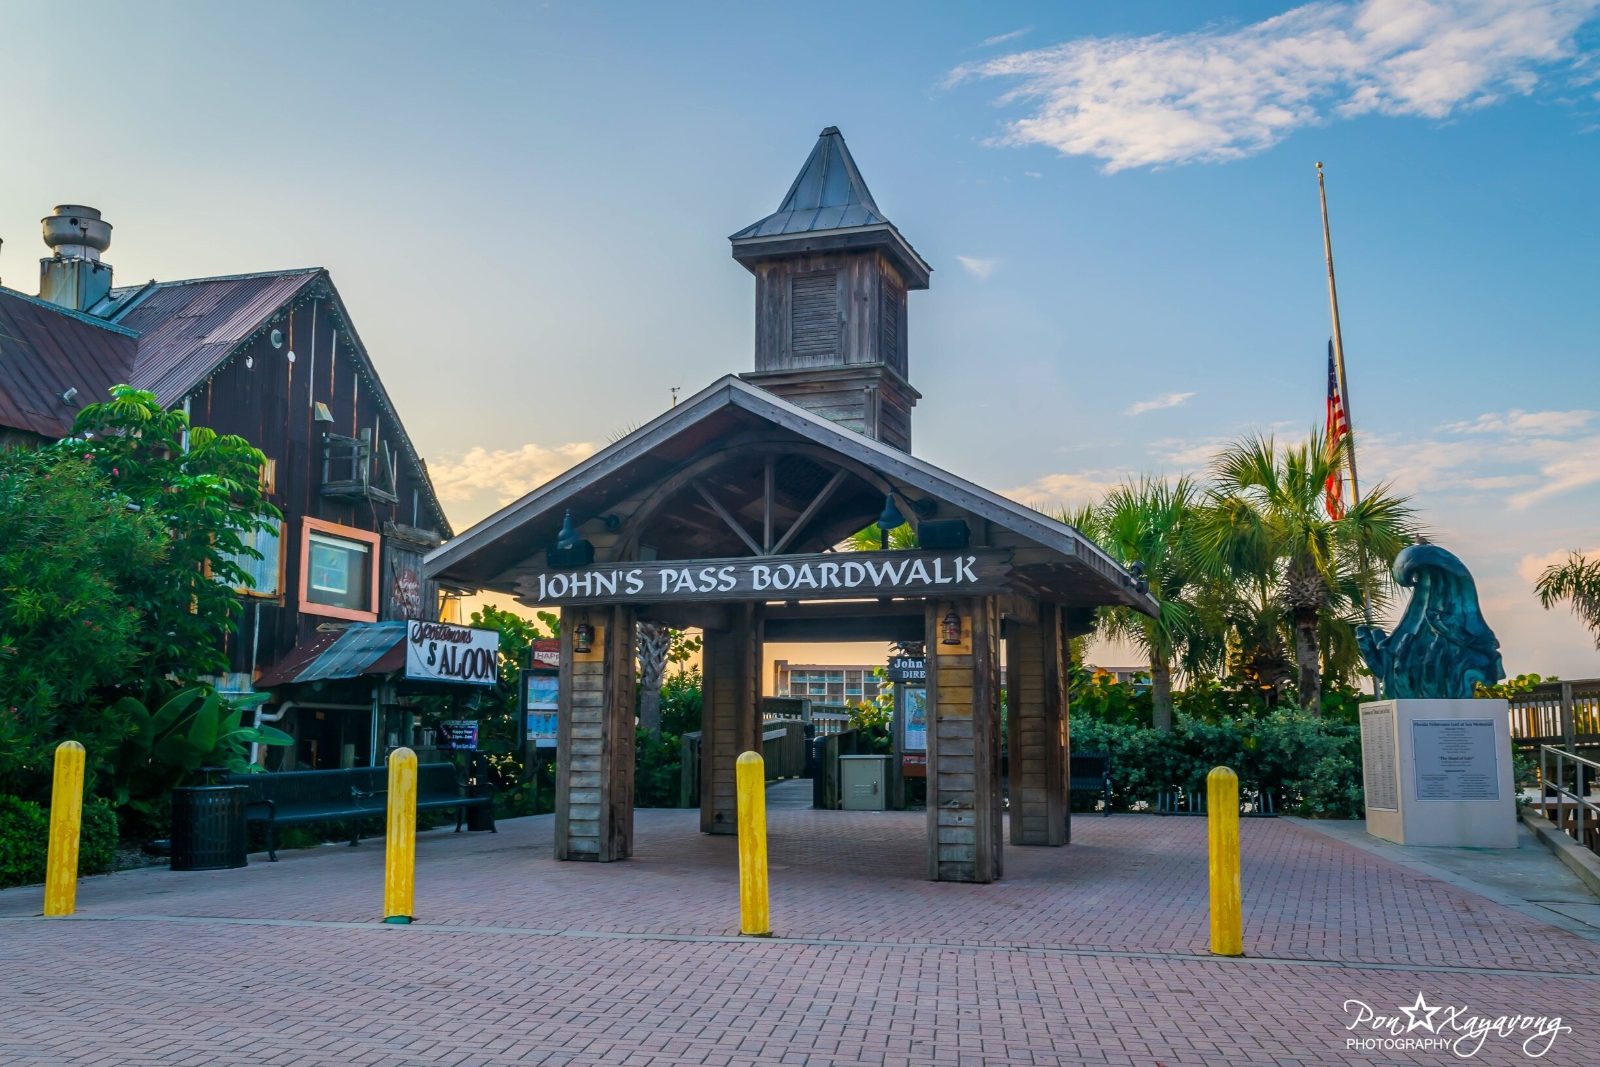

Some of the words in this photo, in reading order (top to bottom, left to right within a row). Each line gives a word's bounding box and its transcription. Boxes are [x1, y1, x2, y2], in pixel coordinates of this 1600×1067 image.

[538, 569, 645, 602] JOHN'S
[658, 565, 737, 595] PASS
[750, 555, 979, 591] BOARDWALK
